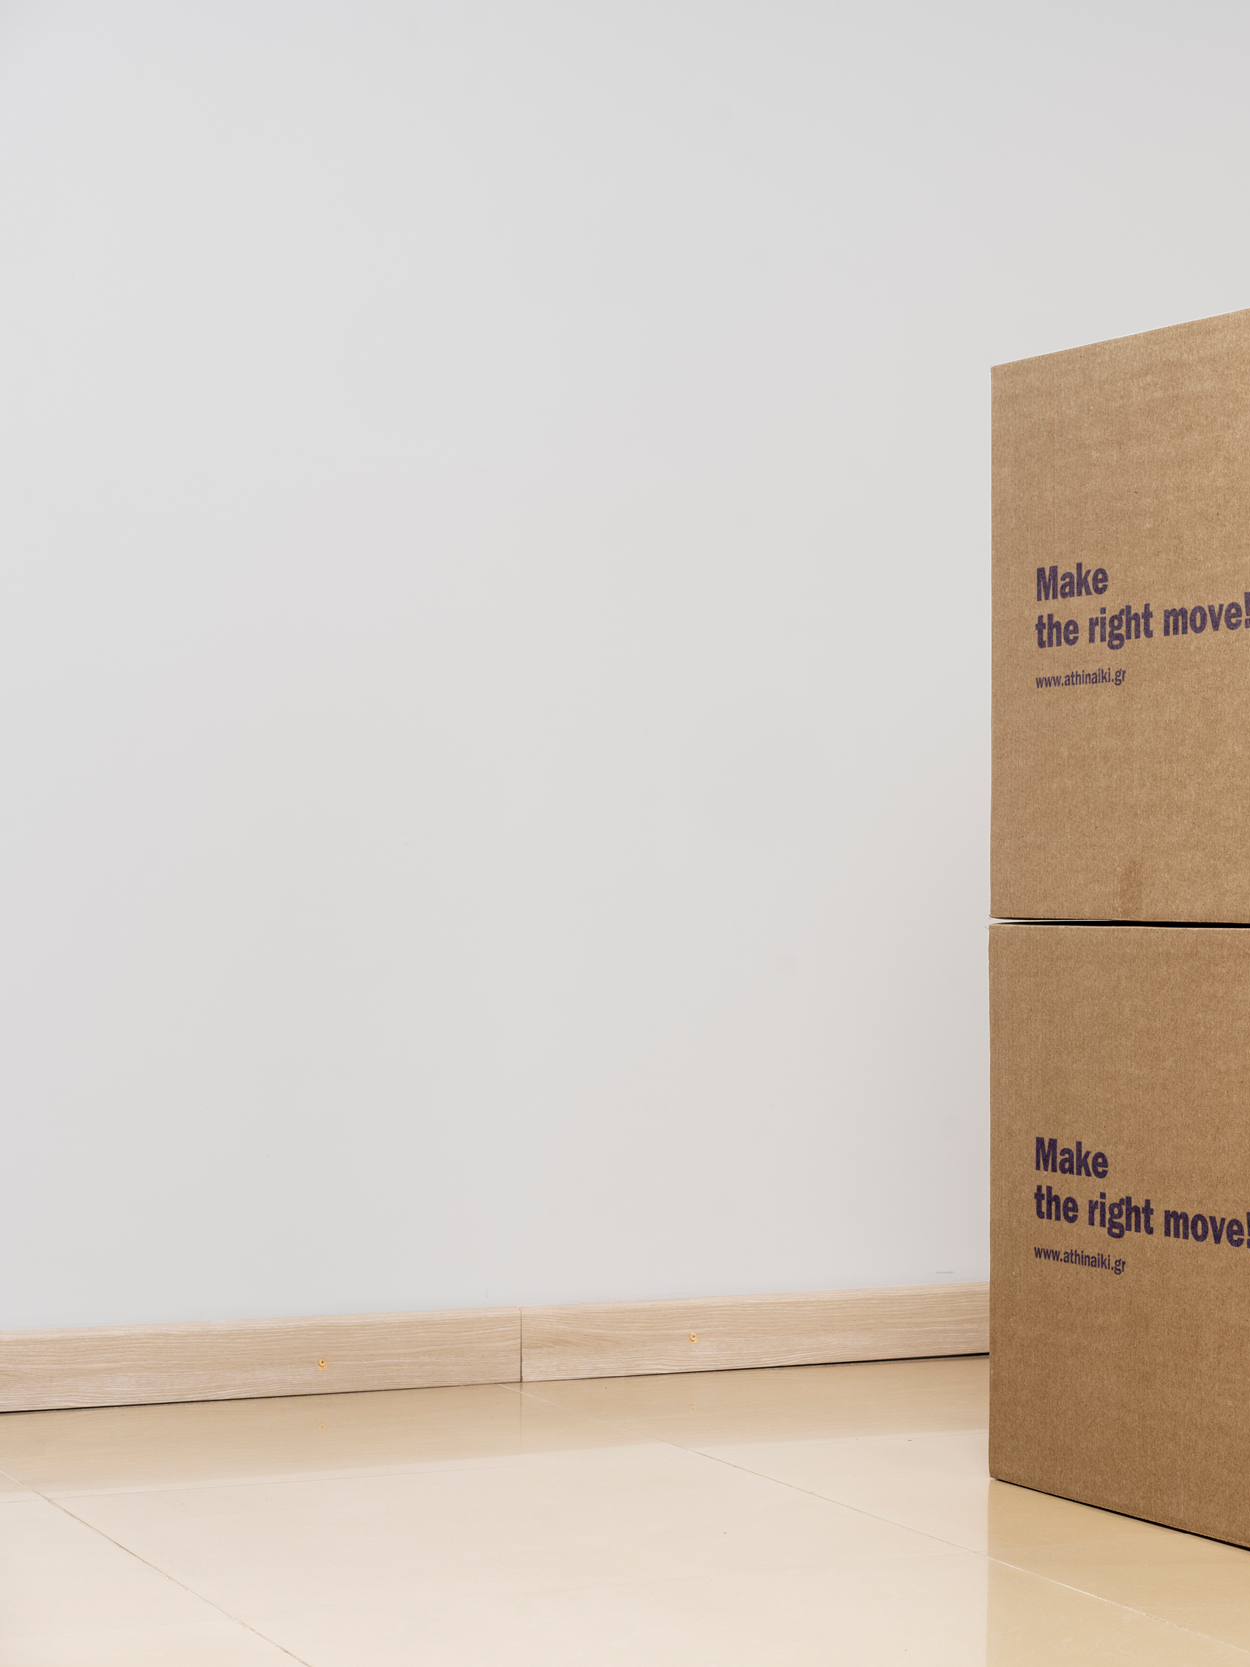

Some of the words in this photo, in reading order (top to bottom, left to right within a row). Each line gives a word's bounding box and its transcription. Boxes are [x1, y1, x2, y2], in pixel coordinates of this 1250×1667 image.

[1036, 562, 1109, 602] Make
[1035, 613, 1080, 650] the
[1088, 603, 1154, 651] right
[1035, 667, 1127, 689] www.athinaiki.gr
[1035, 1136, 1109, 1180] Make
[1034, 1184, 1079, 1225] the
[1087, 1191, 1155, 1240] right
[1034, 1246, 1127, 1276] www.athinaiki.gr
